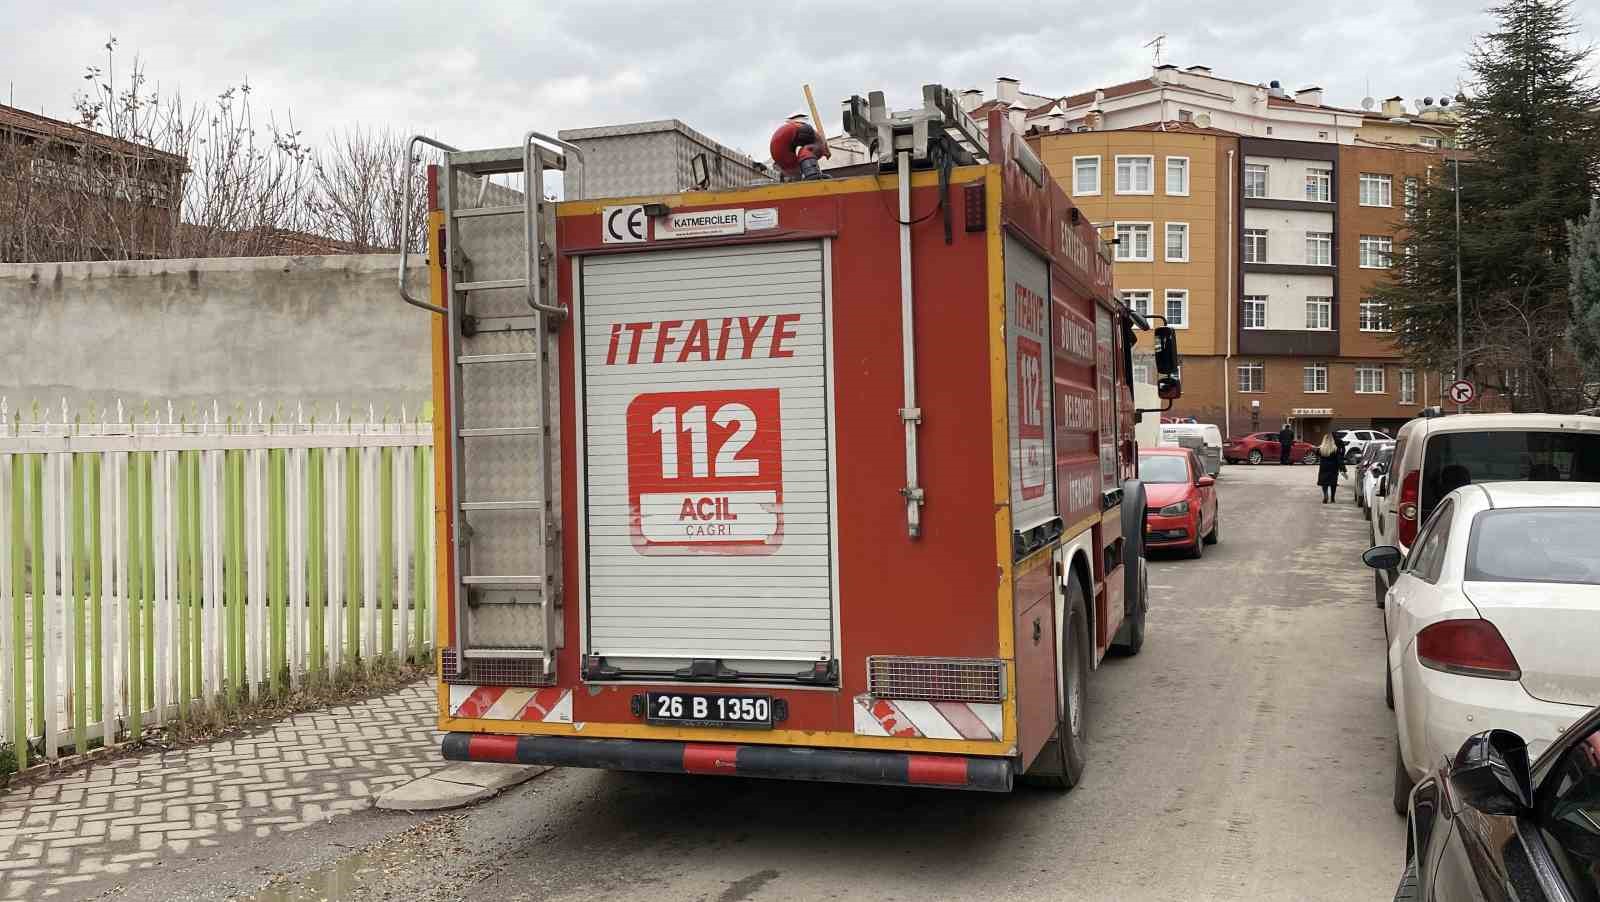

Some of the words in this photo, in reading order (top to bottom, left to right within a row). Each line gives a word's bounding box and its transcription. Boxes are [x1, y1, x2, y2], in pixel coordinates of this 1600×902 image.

[607, 207, 642, 241] CE
[1021, 353, 1041, 426] 112
[652, 403, 759, 479] 112
[658, 695, 683, 717] 26
[693, 697, 708, 718] B
[717, 697, 767, 721] 1350
